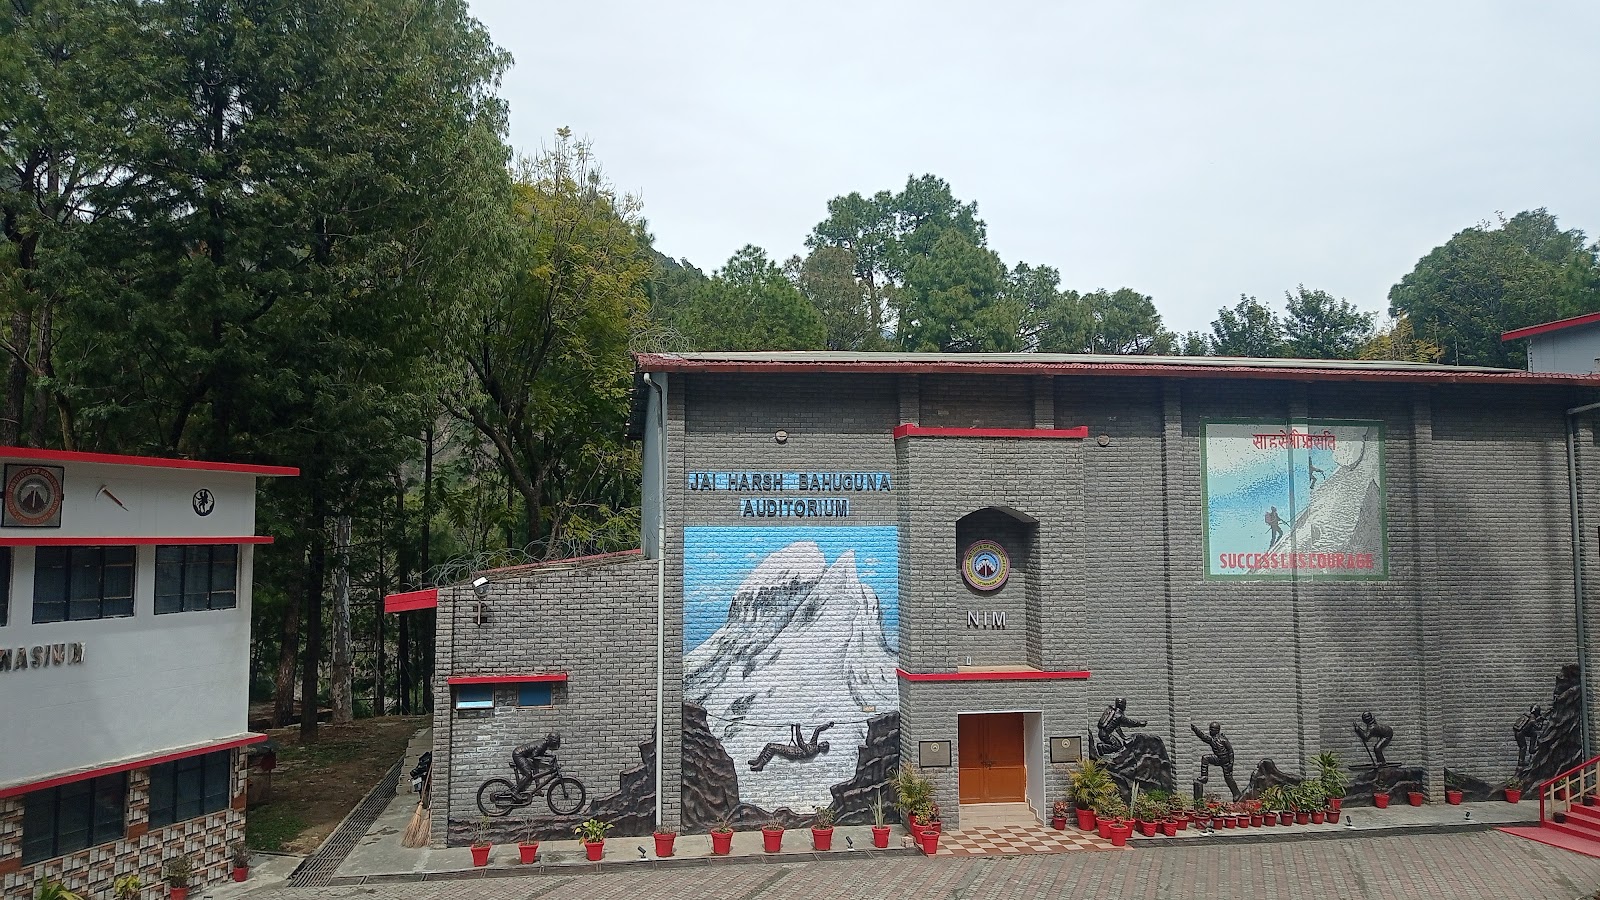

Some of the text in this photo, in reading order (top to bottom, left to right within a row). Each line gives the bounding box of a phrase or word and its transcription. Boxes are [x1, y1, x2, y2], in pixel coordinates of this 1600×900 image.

[690, 473, 890, 490] JAI HARSH BAHUGUNA
[742, 500, 847, 517] AUDITORIUM
[1220, 553, 1278, 568] SUCCESS
[1308, 553, 1374, 568] COURAGE
[967, 610, 1006, 628] NIM
